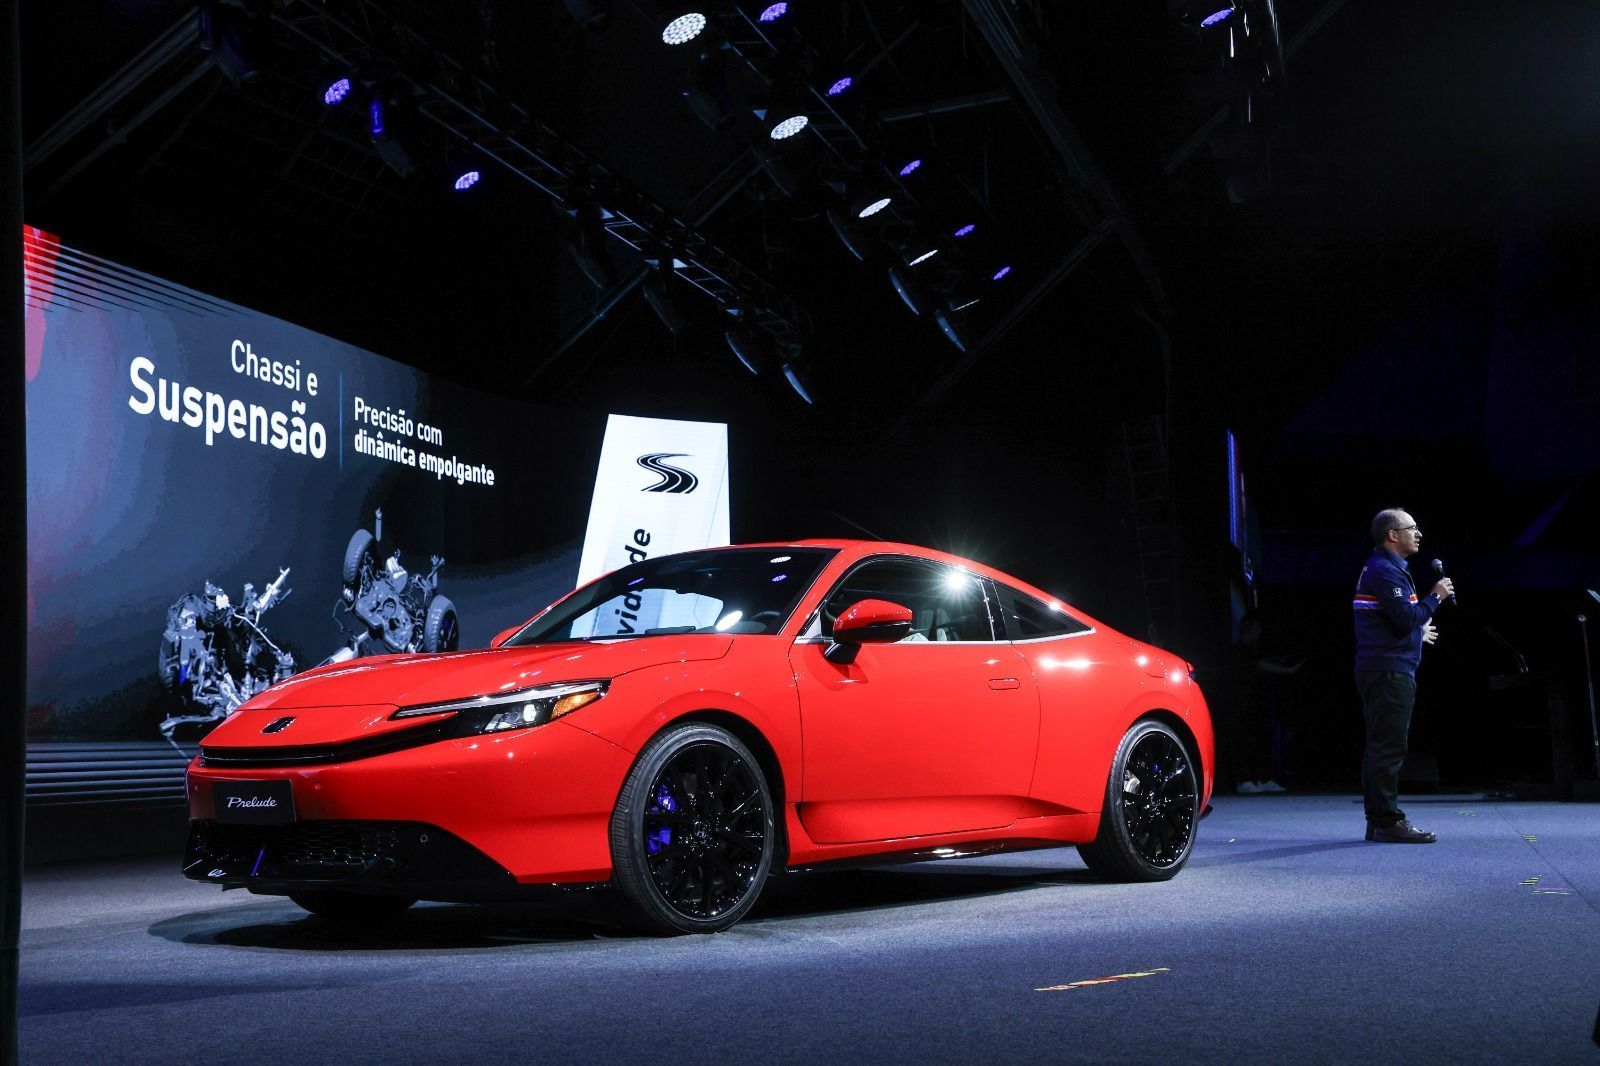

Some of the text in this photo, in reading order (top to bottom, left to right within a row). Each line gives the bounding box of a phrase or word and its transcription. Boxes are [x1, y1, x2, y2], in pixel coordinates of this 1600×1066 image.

[231, 339, 318, 397] Chassi e
[128, 356, 327, 459] Suspensão
[354, 396, 443, 446] Precisão com
[354, 428, 495, 486] dinâmica empolgante
[226, 796, 277, 808] Prelude
